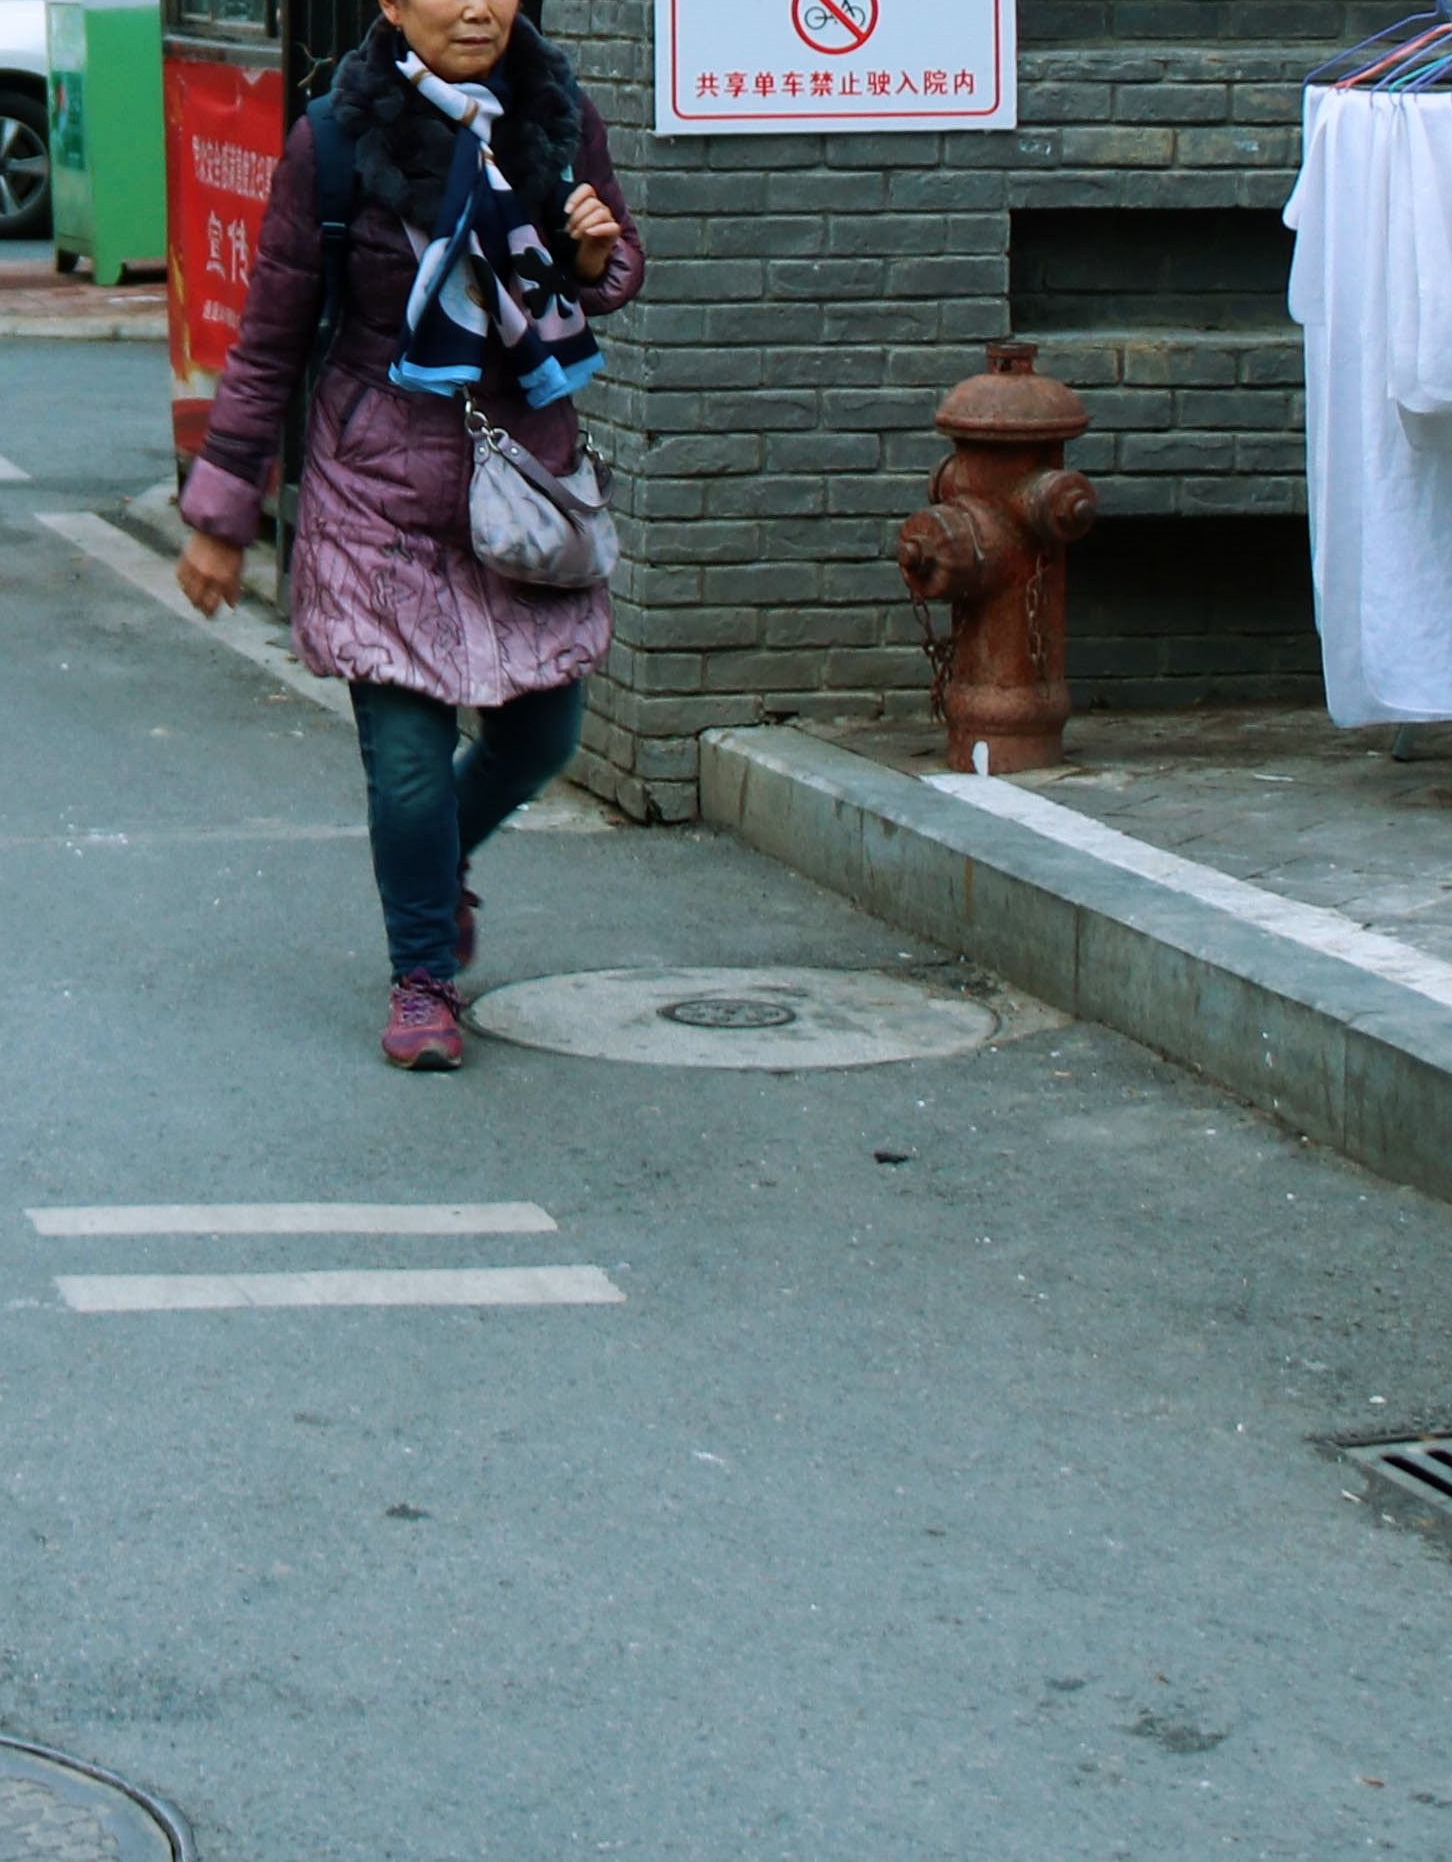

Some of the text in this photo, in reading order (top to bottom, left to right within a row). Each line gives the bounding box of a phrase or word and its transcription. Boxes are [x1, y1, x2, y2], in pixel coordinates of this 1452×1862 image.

[695, 68, 977, 98] 共享单车禁止驶入院内
